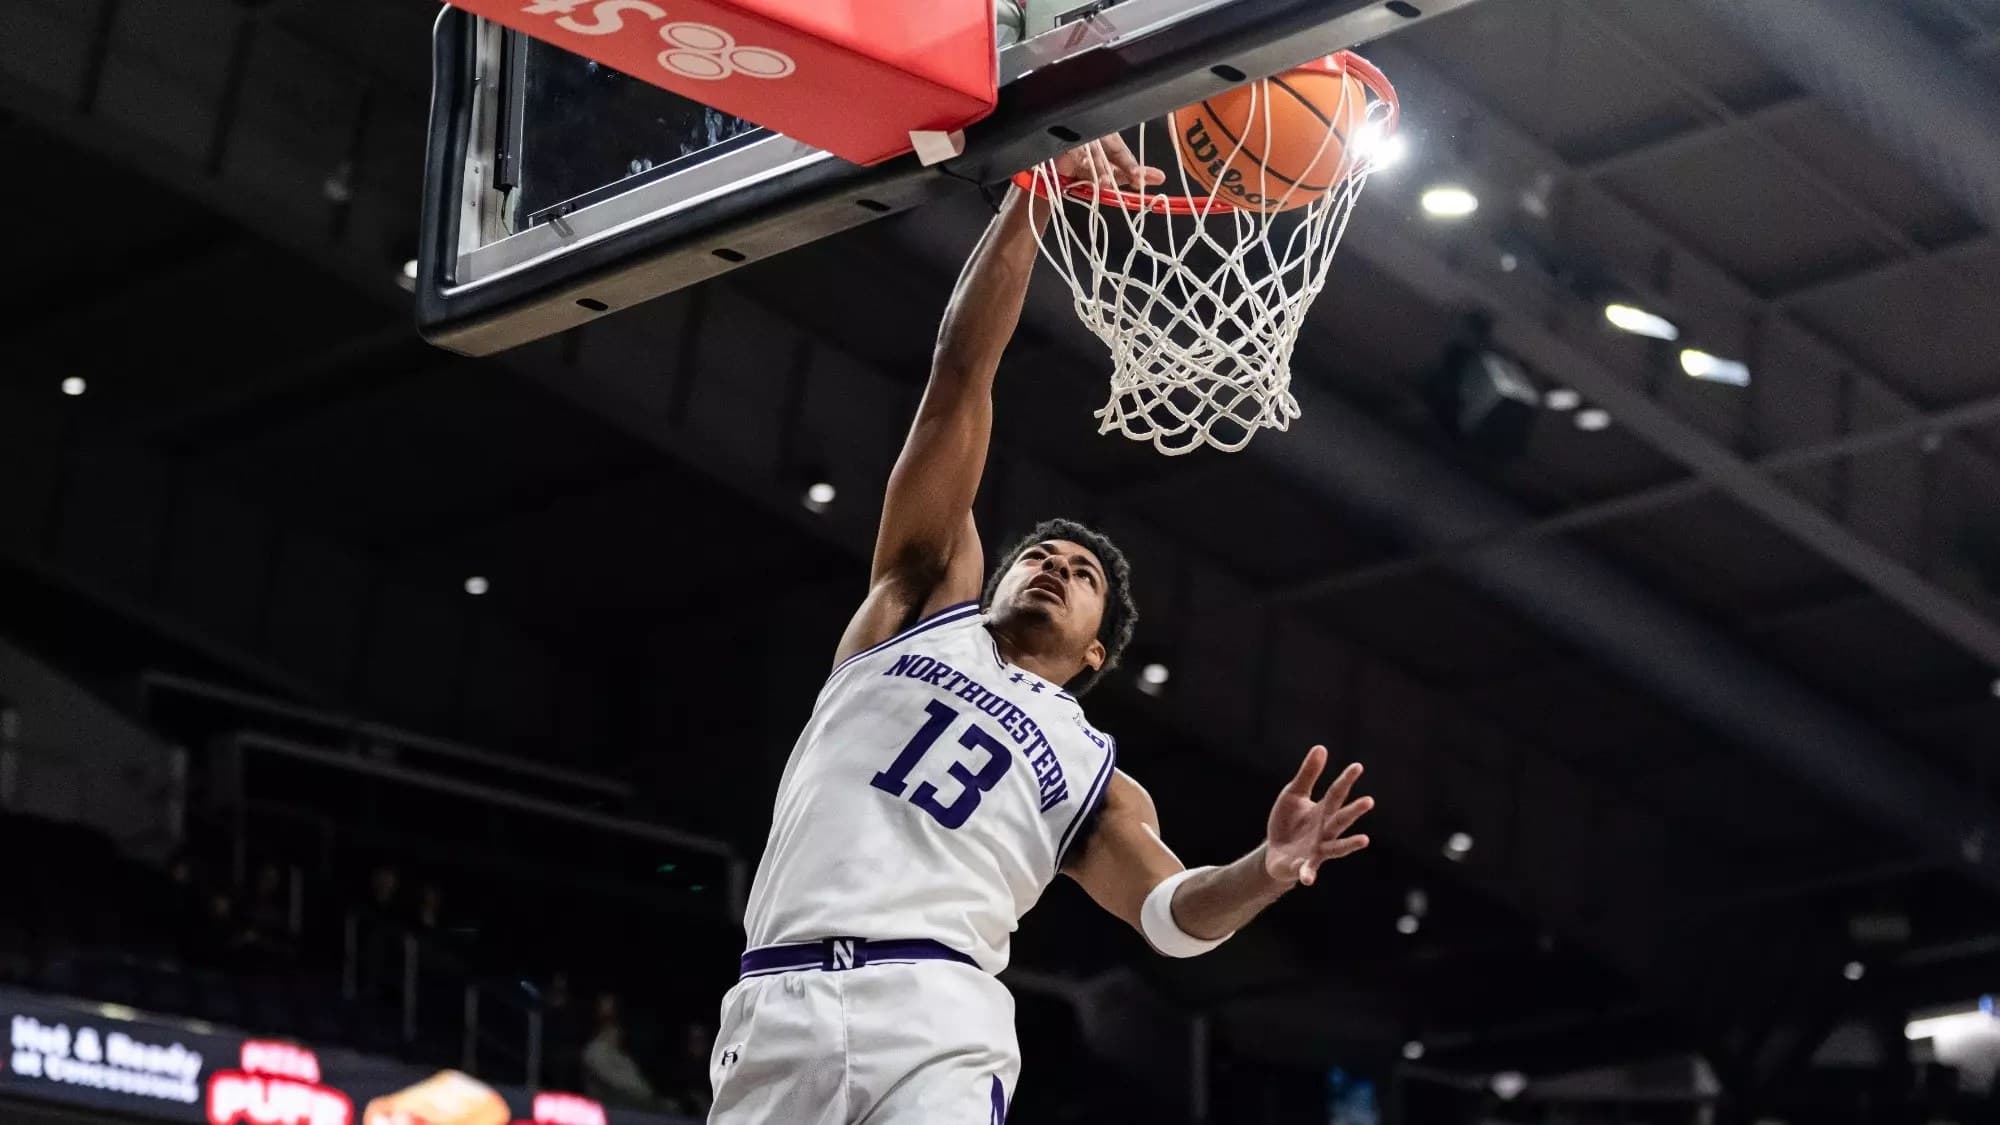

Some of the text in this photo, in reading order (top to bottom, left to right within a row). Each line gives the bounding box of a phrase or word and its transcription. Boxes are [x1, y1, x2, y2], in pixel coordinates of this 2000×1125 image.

[1186, 117, 1288, 207] Wilson
[870, 698, 1013, 830] 13
[883, 654, 1069, 814] NORTHWESTERN
[832, 940, 854, 969] N
[73, 1026, 102, 1063] &
